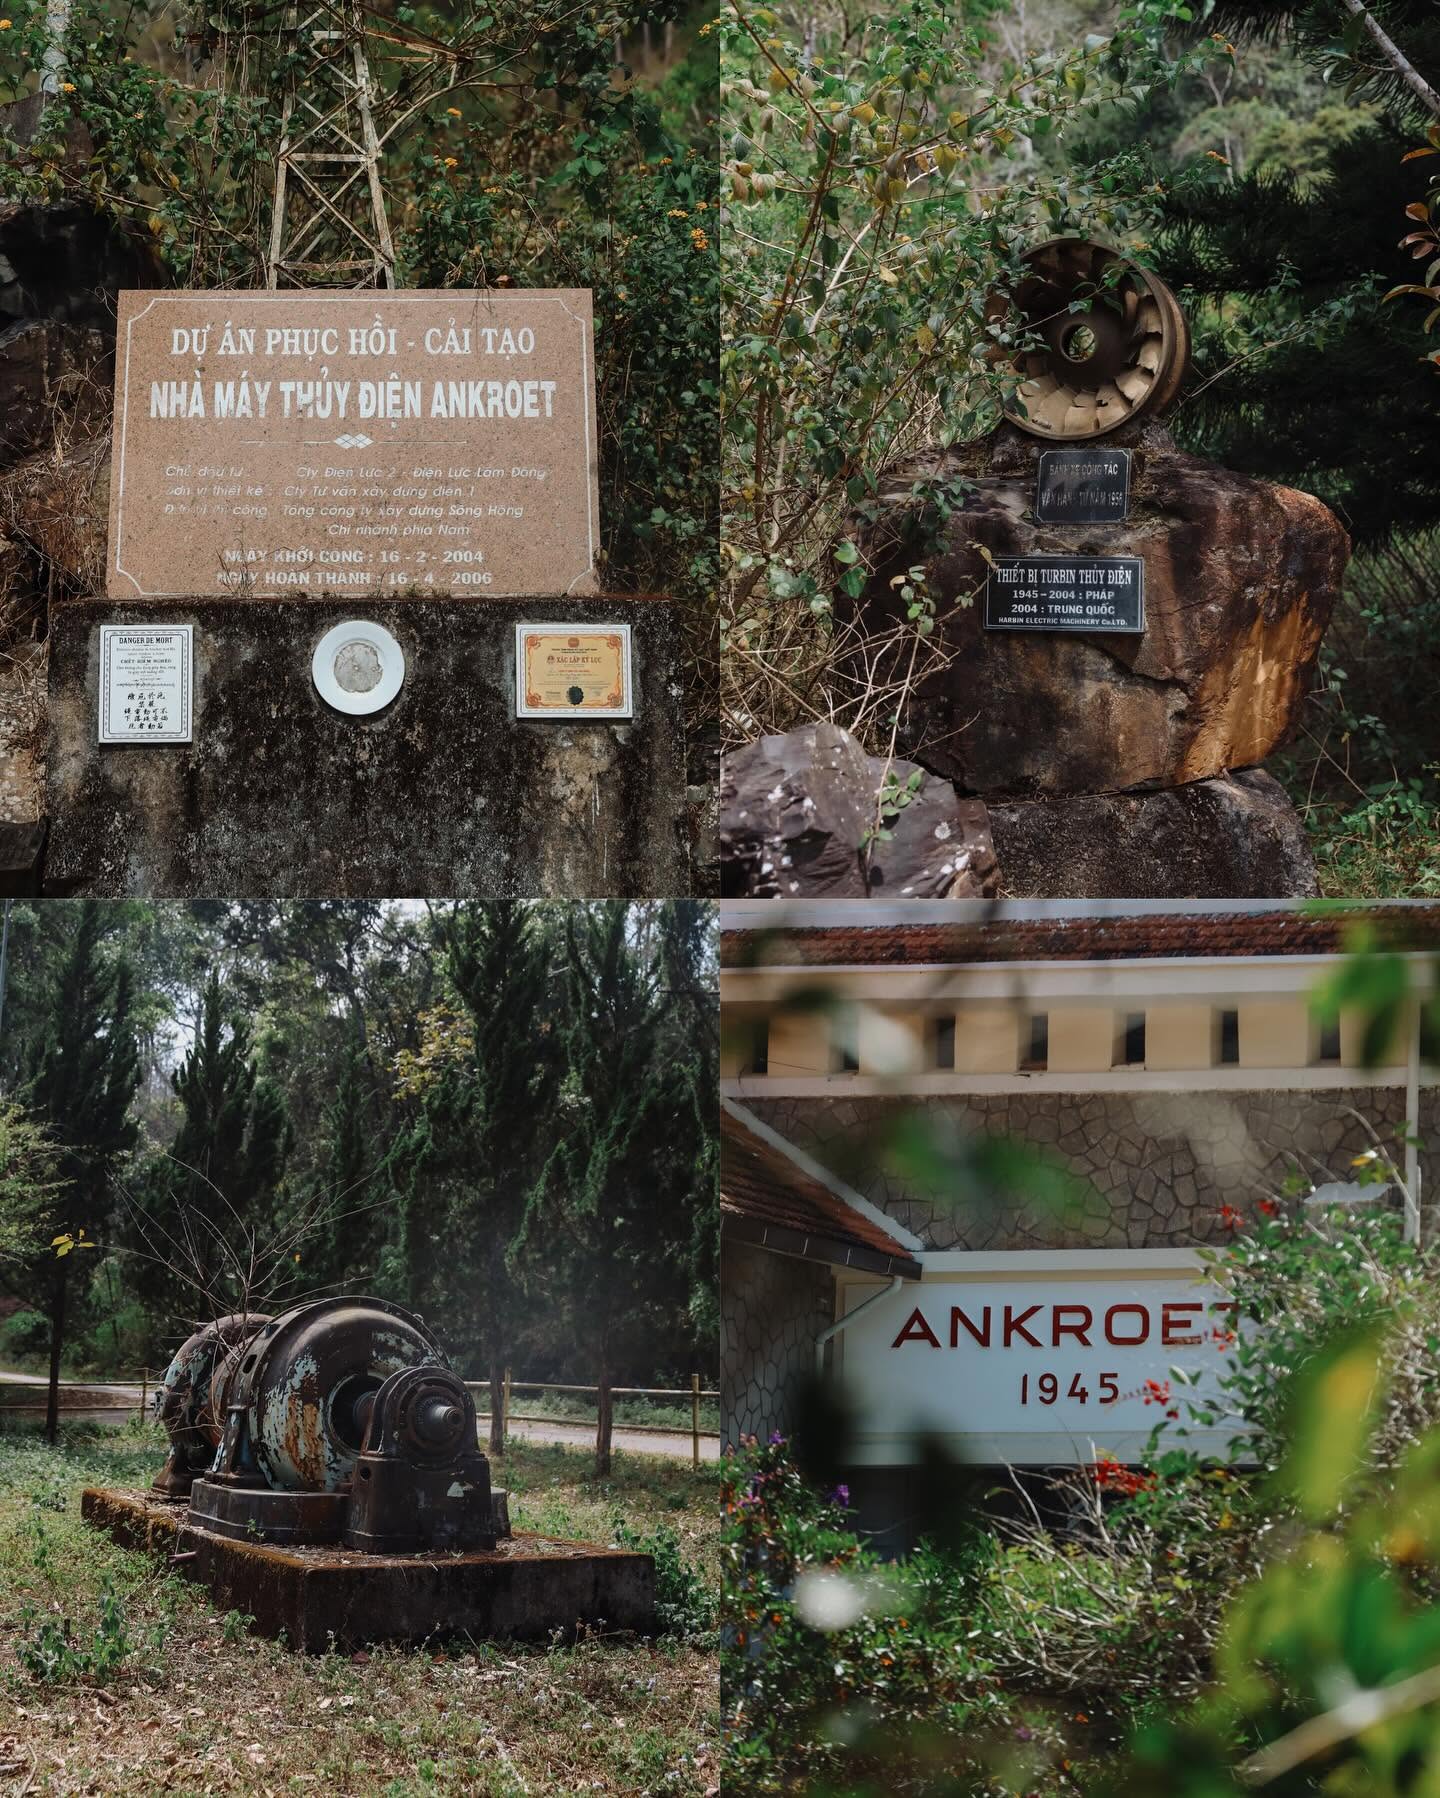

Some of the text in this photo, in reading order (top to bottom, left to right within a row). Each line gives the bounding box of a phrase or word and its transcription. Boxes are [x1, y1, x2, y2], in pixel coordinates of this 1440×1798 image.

[171, 323, 211, 362] DỰ
[217, 321, 256, 355] ÁN
[265, 327, 339, 362] PHỤC
[348, 313, 398, 355] HỒI
[424, 317, 472, 355] CẢI
[480, 327, 535, 361] TẠO
[150, 366, 557, 428] NHÀ MÁY THỦY ĐIỆN ANKROET
[1103, 460, 1119, 475] TÁC
[438, 524, 471, 536] Nam
[381, 551, 400, 562] 16
[416, 551, 426, 562] 2
[442, 551, 484, 563] 2004
[388, 572, 408, 584] 16
[424, 572, 434, 584] 4
[451, 572, 493, 584] 2006
[996, 562, 1132, 588] THIẾT BỊ TURBIN THỦY ĐIỆN
[1013, 590, 1039, 599] 1945
[1049, 590, 1076, 599] 2004
[1085, 588, 1115, 600] PHÁP
[1011, 604, 1038, 613] 2004
[1048, 604, 1083, 614] TRUNG
[1085, 602, 1115, 615] QUỐC
[998, 616, 1024, 624] HARBIN
[1060, 617, 1100, 625] MACHINERY
[1020, 1372, 1119, 1405] 1945
